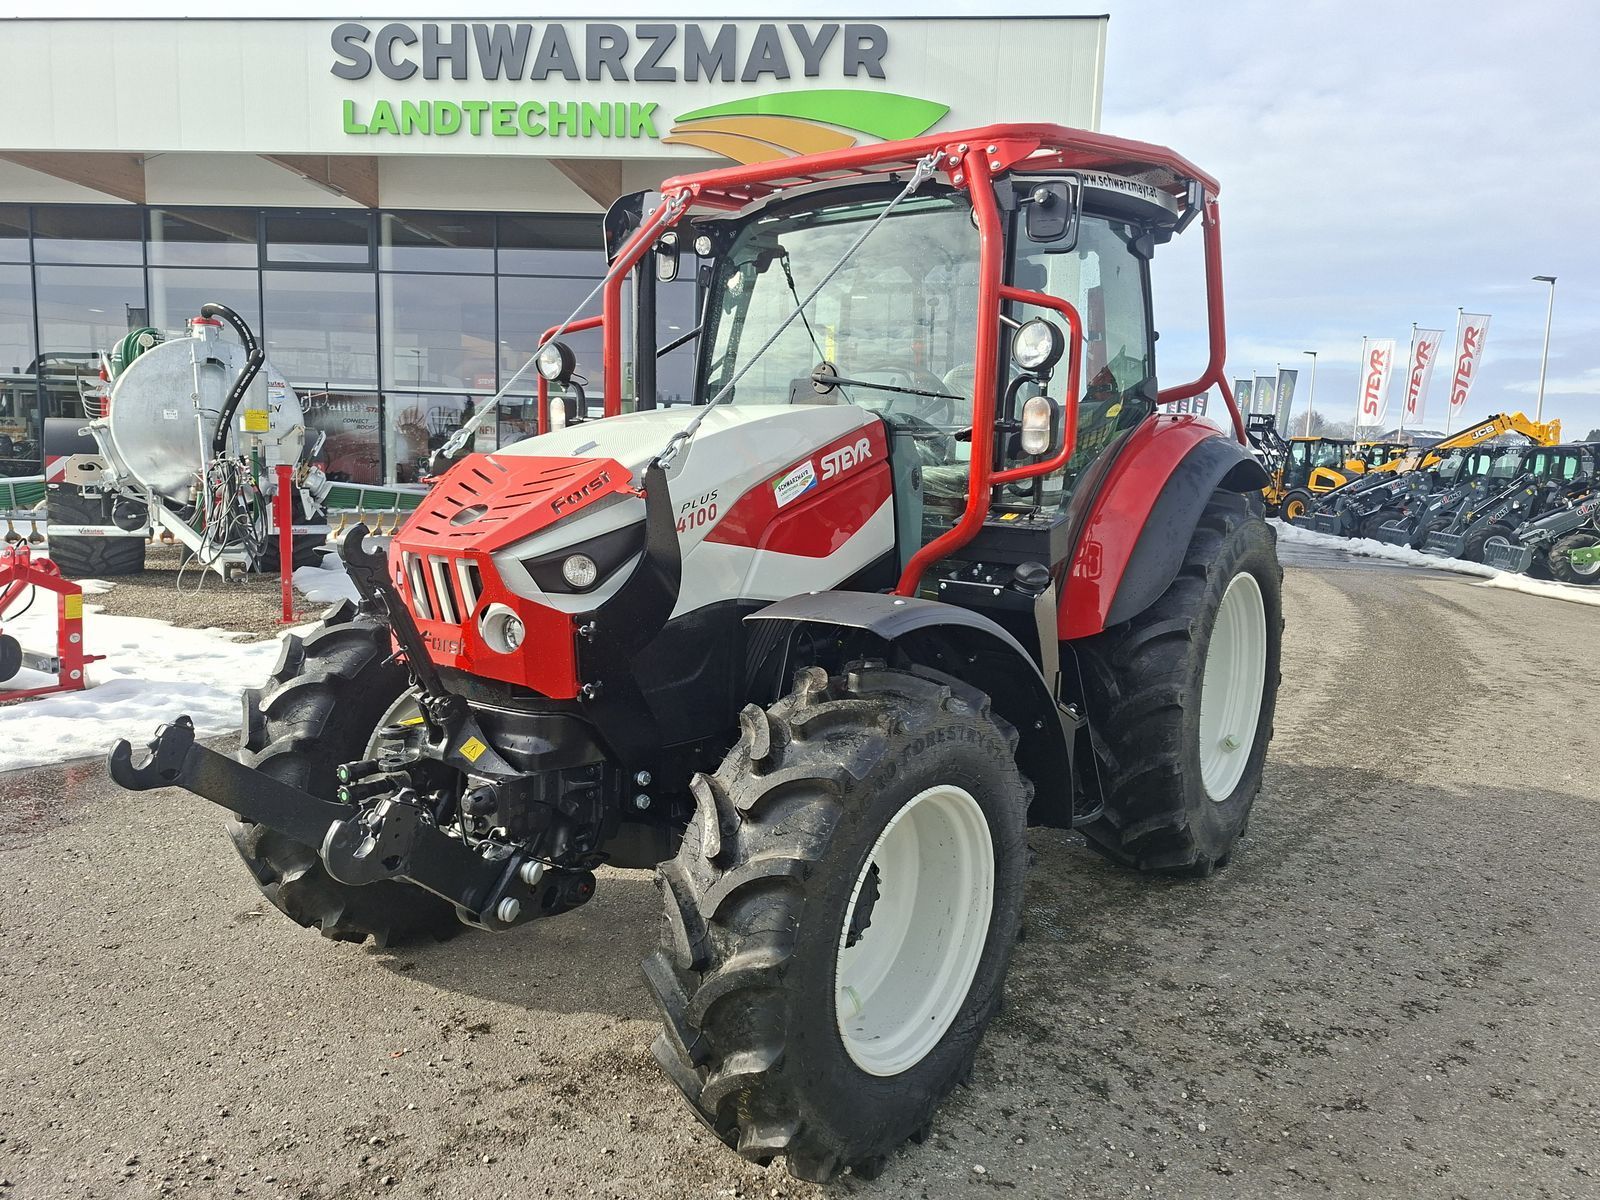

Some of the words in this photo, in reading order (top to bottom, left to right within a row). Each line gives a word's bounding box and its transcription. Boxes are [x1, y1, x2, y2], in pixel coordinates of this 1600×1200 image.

[330, 23, 888, 82] SCHWARZMAYR
[343, 99, 659, 138] LANDTECHNIK
[1081, 173, 1157, 198] ww.schwarzmayr.at
[1363, 349, 1385, 416] STEYR
[1407, 341, 1432, 414] STEYR
[1451, 326, 1480, 405] STEYR
[1472, 425, 1495, 440] JCB
[821, 437, 873, 481] STEYR
[551, 469, 612, 515] Forst
[777, 469, 809, 492] SCHWARZMAYR
[676, 503, 718, 533] 4100
[681, 489, 719, 514] PLUS
[1487, 506, 1508, 526] GIANT
[1576, 501, 1600, 516] GIAN
[900, 725, 986, 762] FORESTRY
